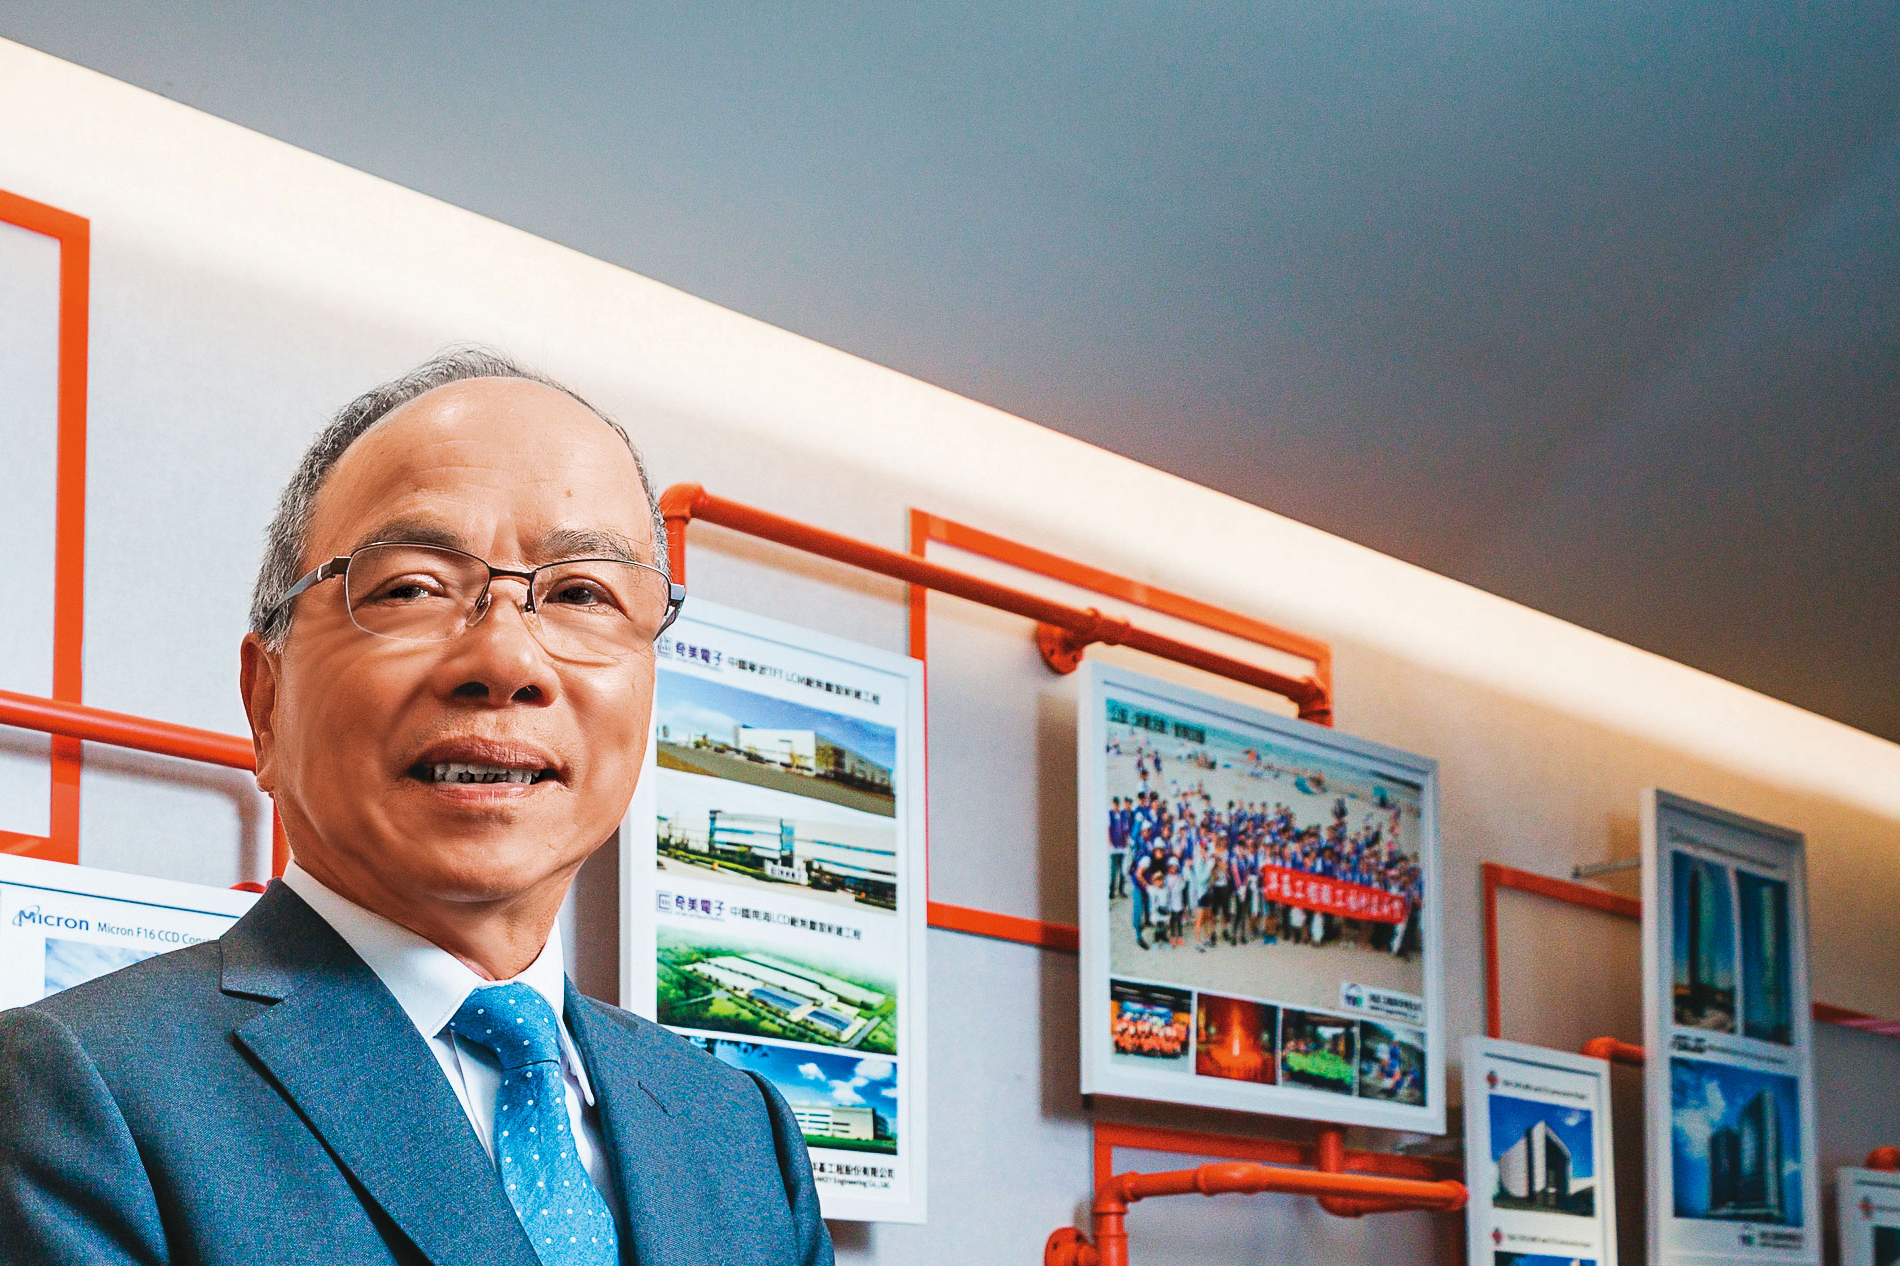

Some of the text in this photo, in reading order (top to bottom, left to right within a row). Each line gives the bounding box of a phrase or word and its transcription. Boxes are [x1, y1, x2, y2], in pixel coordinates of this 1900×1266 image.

[18, 909, 210, 946] Micron Micron F16 CCD Con
